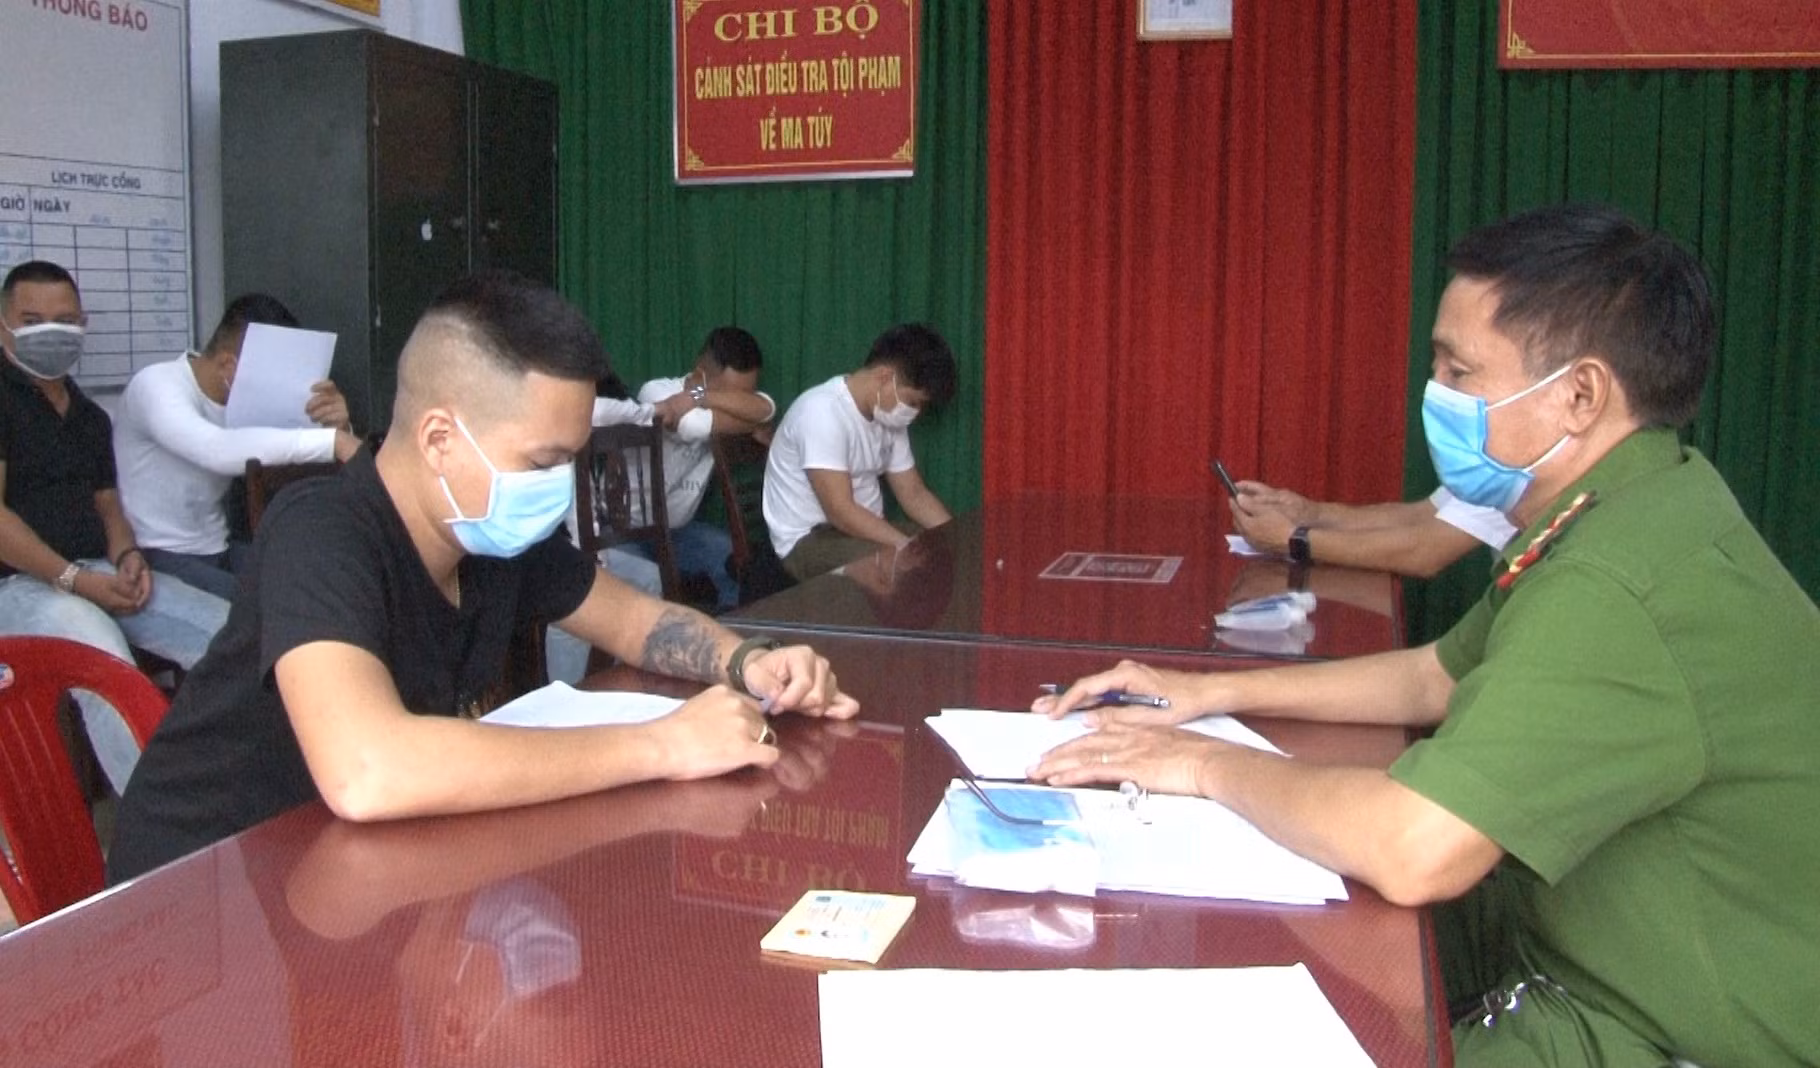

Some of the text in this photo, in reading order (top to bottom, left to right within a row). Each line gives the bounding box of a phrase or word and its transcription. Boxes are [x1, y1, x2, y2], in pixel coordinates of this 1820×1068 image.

[108, 3, 148, 31] BÁO
[714, 0, 879, 41] CHI BỘ
[736, 54, 762, 97] SÁT
[801, 60, 829, 93] TRA
[832, 50, 854, 98] TỘI
[858, 55, 901, 97] PHẠM
[781, 116, 804, 149] MA
[807, 106, 833, 148] TÚY
